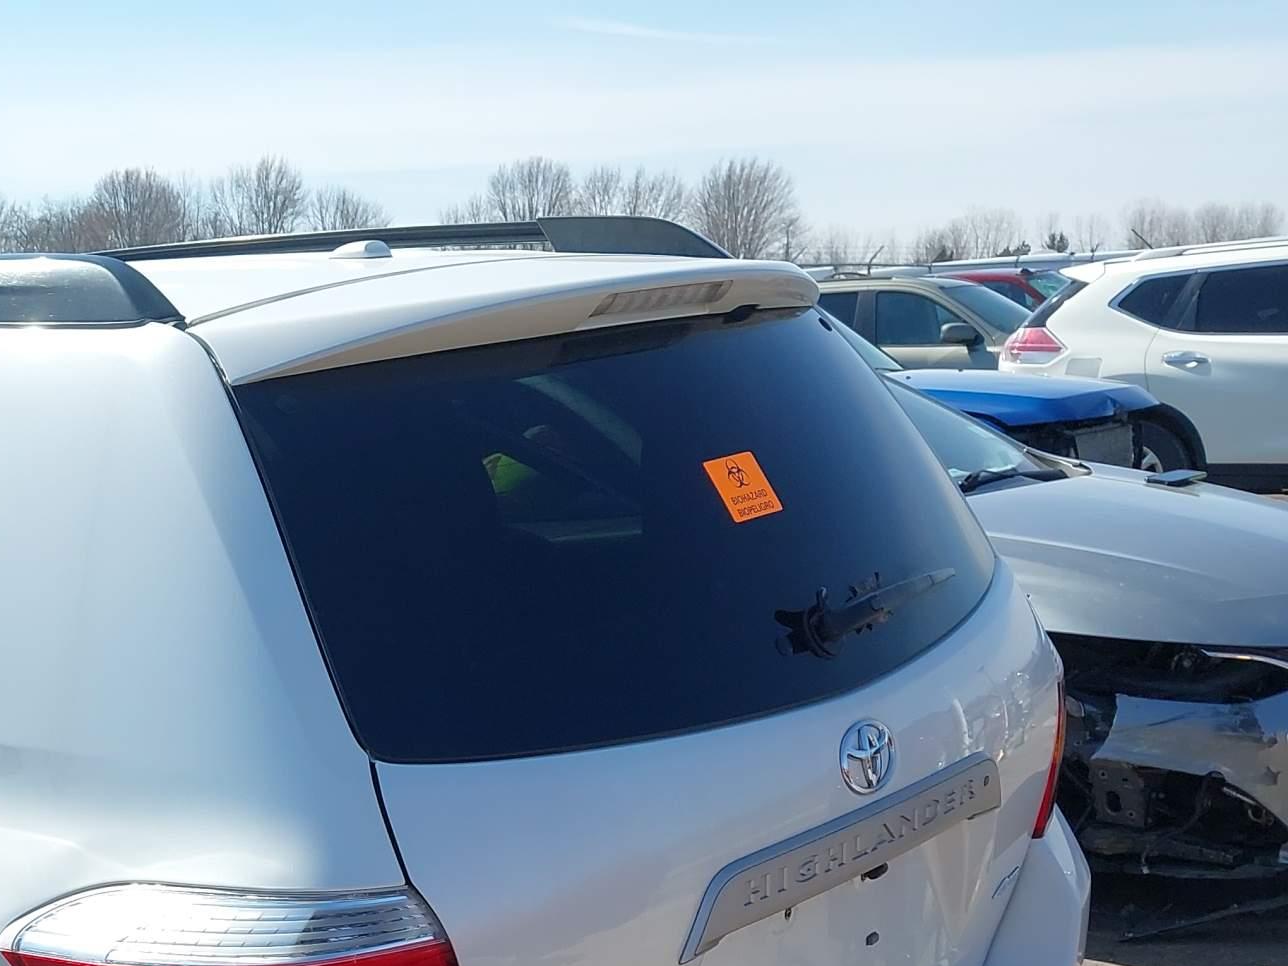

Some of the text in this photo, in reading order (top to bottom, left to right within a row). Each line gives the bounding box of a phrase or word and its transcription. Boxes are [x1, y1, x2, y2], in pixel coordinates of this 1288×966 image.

[731, 488, 768, 505] BIOHAZARD
[737, 500, 775, 517] BIOPELIGRO
[743, 779, 976, 906] HIGHLANDER
